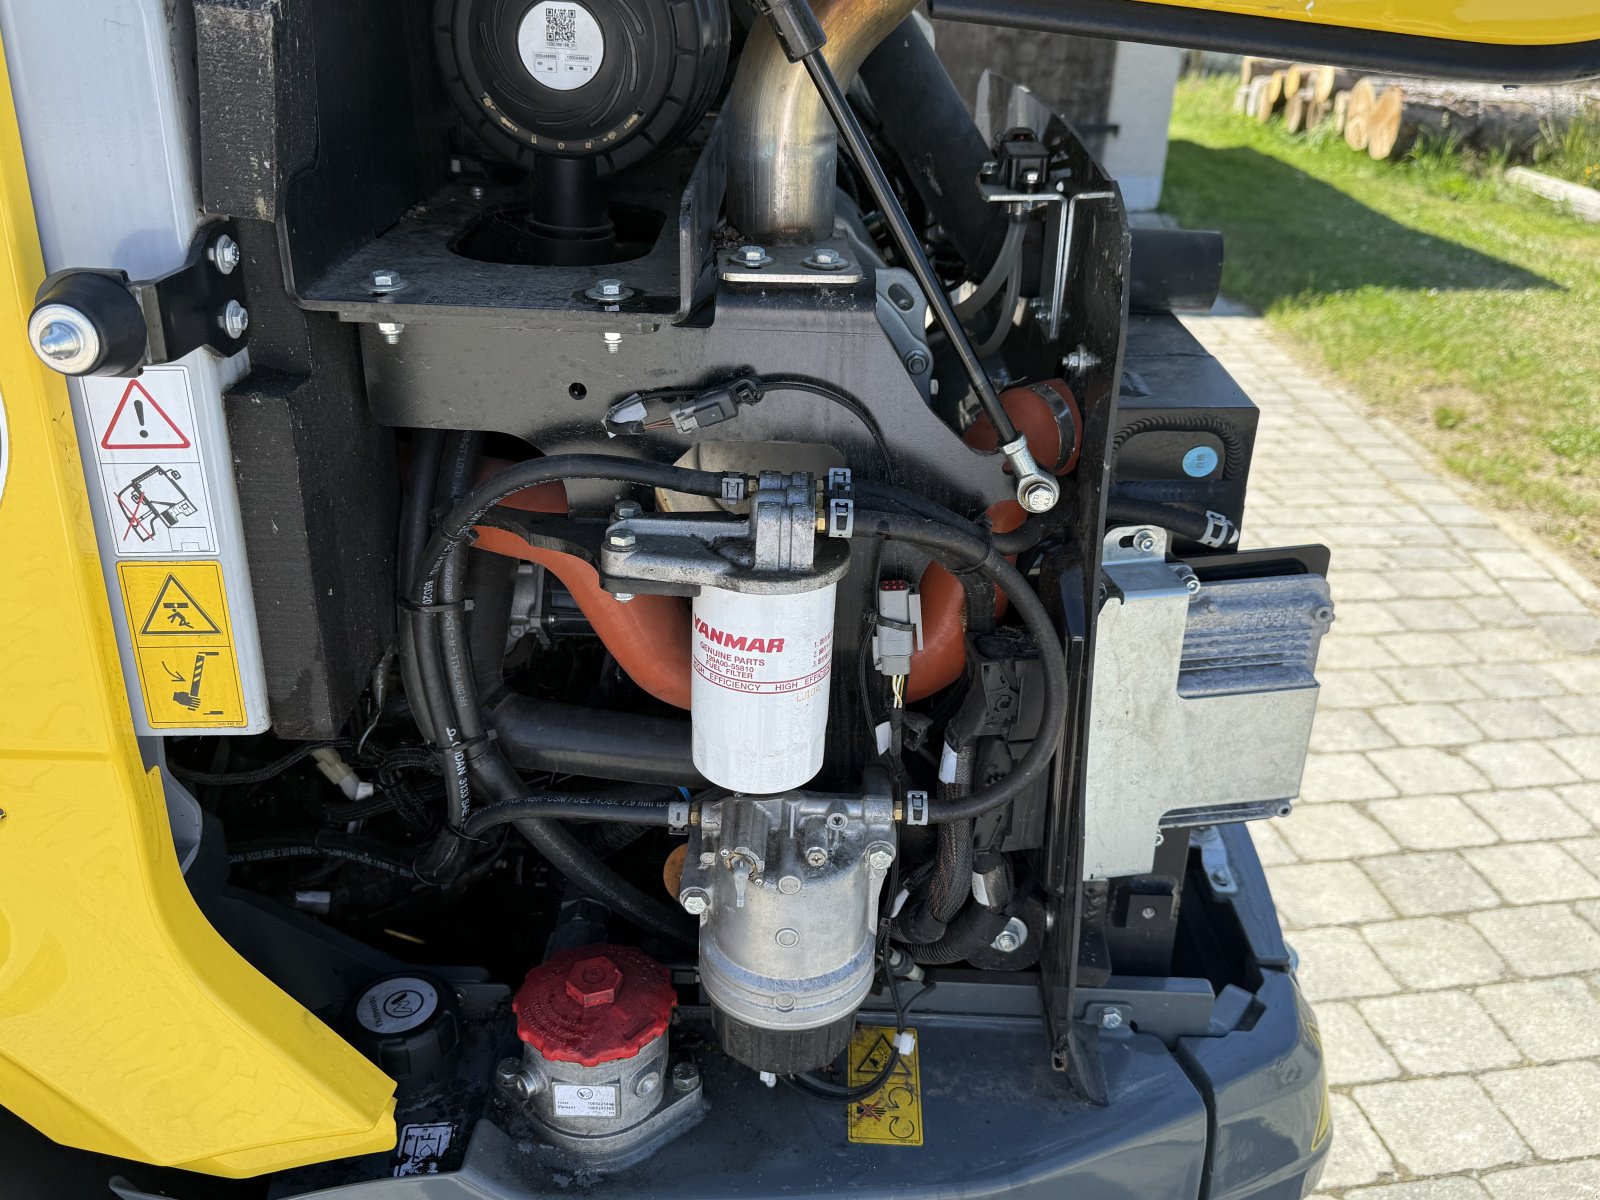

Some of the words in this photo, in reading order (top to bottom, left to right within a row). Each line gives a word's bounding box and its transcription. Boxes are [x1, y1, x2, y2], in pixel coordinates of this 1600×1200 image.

[444, 563, 454, 600] 2023/02
[694, 612, 785, 653] YANMAR
[700, 641, 732, 662] GENUINE
[734, 656, 765, 667] PARTS
[705, 653, 754, 673] 129A00-55810
[705, 660, 723, 673] FUEL
[726, 668, 753, 680] FILTER
[709, 672, 761, 692] EFFICIENCY
[775, 681, 798, 692] HIGH
[459, 777, 469, 799] 3133
